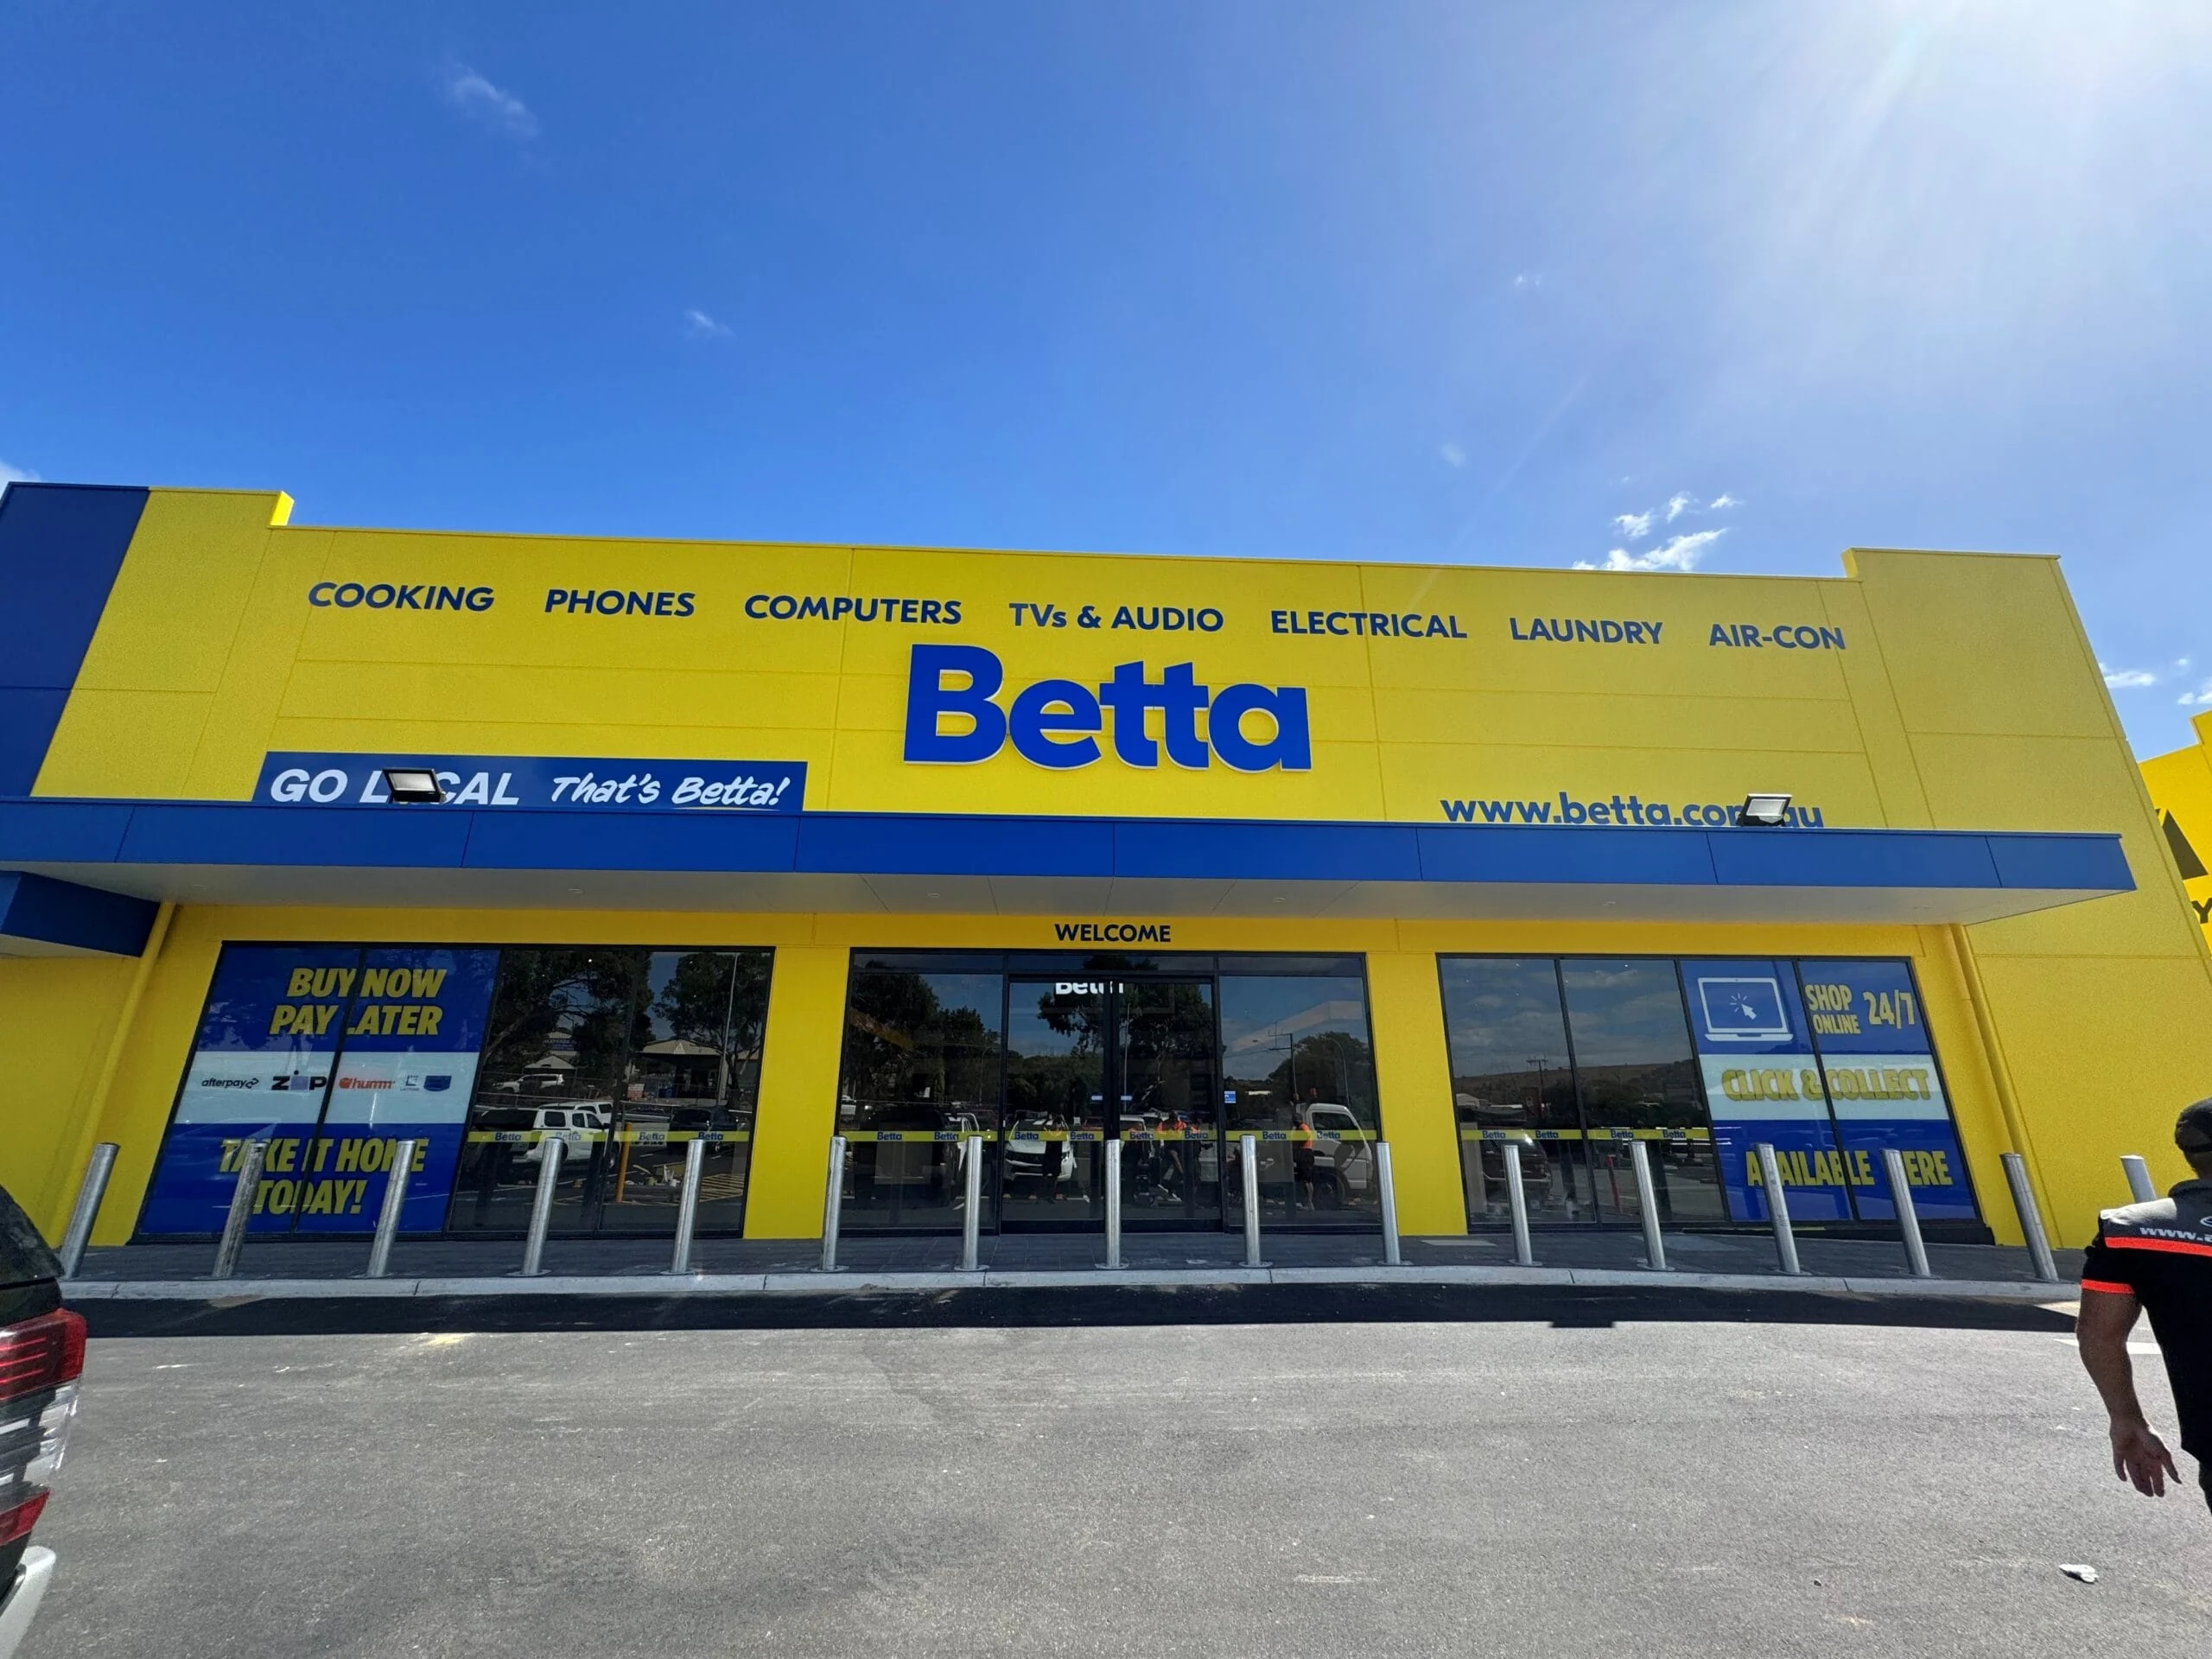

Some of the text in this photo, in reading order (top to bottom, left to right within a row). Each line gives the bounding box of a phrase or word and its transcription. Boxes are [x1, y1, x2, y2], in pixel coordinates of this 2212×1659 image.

[308, 582, 1847, 651] COOKING PHONES COMPUTERS TVs & AUDIO ELECTRICAL LAUNDRY AIR-CON
[905, 644, 1312, 772] Betta
[270, 768, 791, 805] GO LCAL That's Betta!
[1440, 791, 1825, 827] www.betta.coau
[1055, 924, 1172, 943] WELCOME
[286, 968, 448, 998] BUY NOW
[1805, 984, 1915, 1029] SHOP 24/7
[269, 1005, 340, 1035] PAY
[1813, 1014, 1861, 1034] ONLINE
[201, 1077, 246, 1089] afterpay
[1721, 1069, 1799, 1101] CLICK
[1825, 1069, 1932, 1101] COLLECT
[494, 1131, 522, 1141] Betta
[697, 1131, 723, 1141] Betta
[877, 1131, 959, 1141] Betta Betta
[1014, 1131, 1095, 1141] Betta Betta
[1185, 1131, 1209, 1141] Betta
[1262, 1130, 1287, 1141] Betta
[1482, 1129, 1559, 1140] Betta Betta
[1745, 1150, 1953, 1186] AAILABLE ERE
